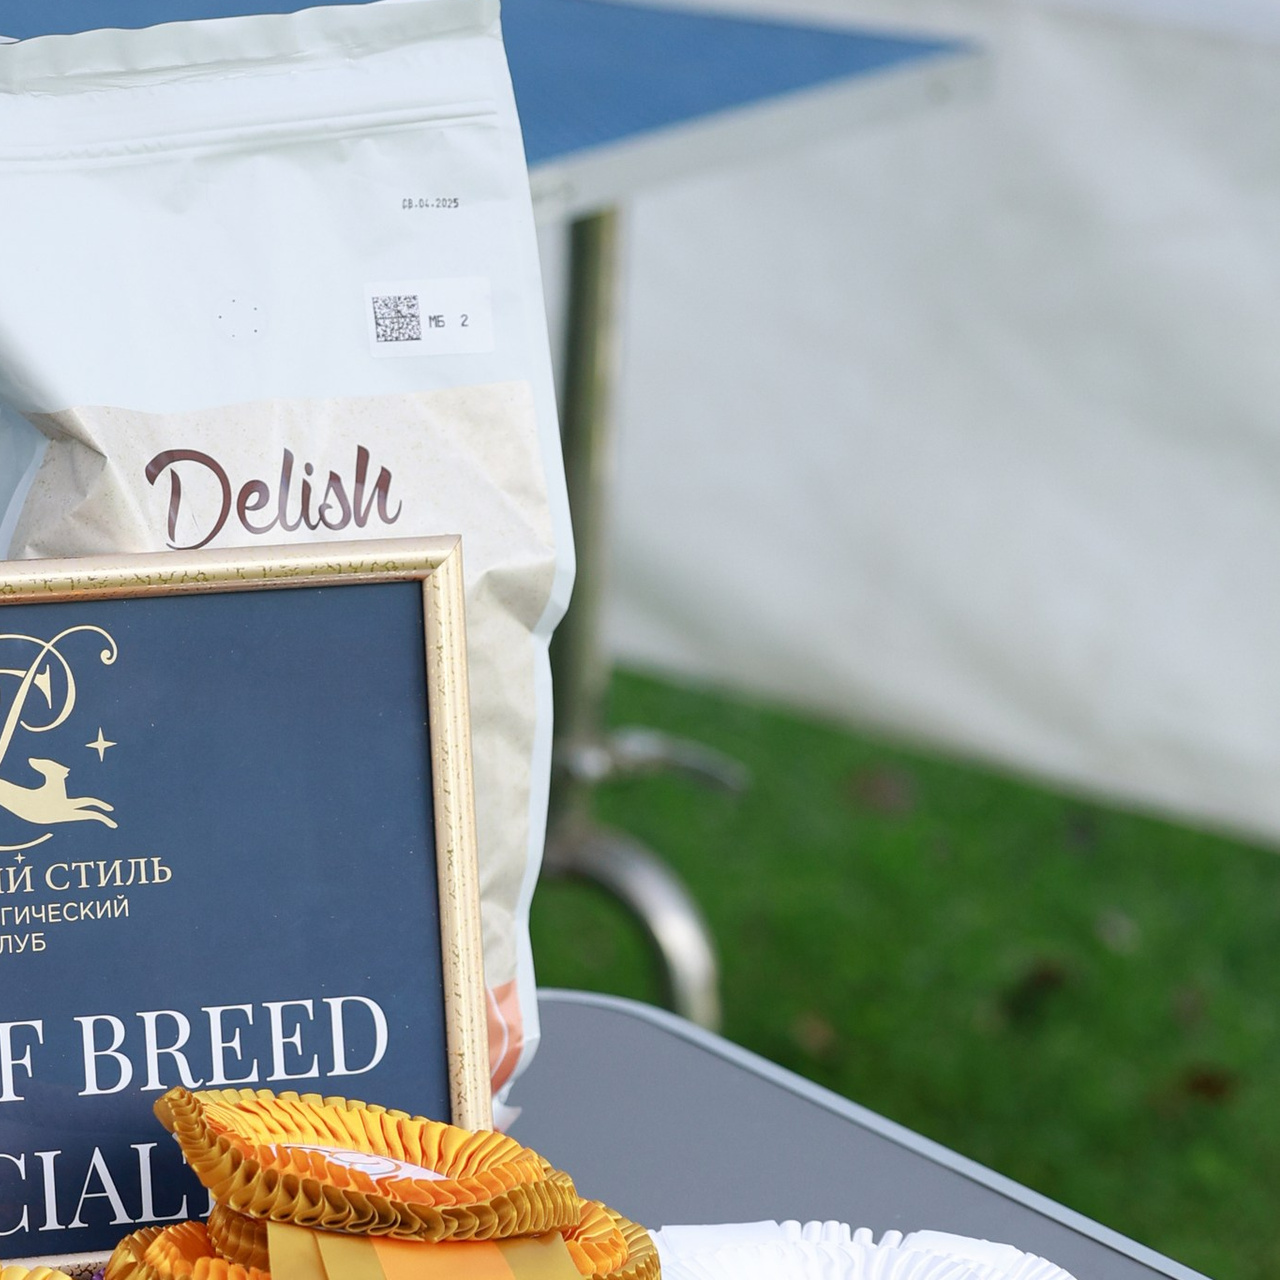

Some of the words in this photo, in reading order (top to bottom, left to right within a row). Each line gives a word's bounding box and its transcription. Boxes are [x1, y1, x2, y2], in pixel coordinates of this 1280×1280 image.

[428, 314, 446, 328] МБ
[460, 313, 470, 327] 2
[145, 444, 402, 550] Delish
[45, 857, 172, 889] СТИЛЬ
[74, 995, 388, 1098] BREED
